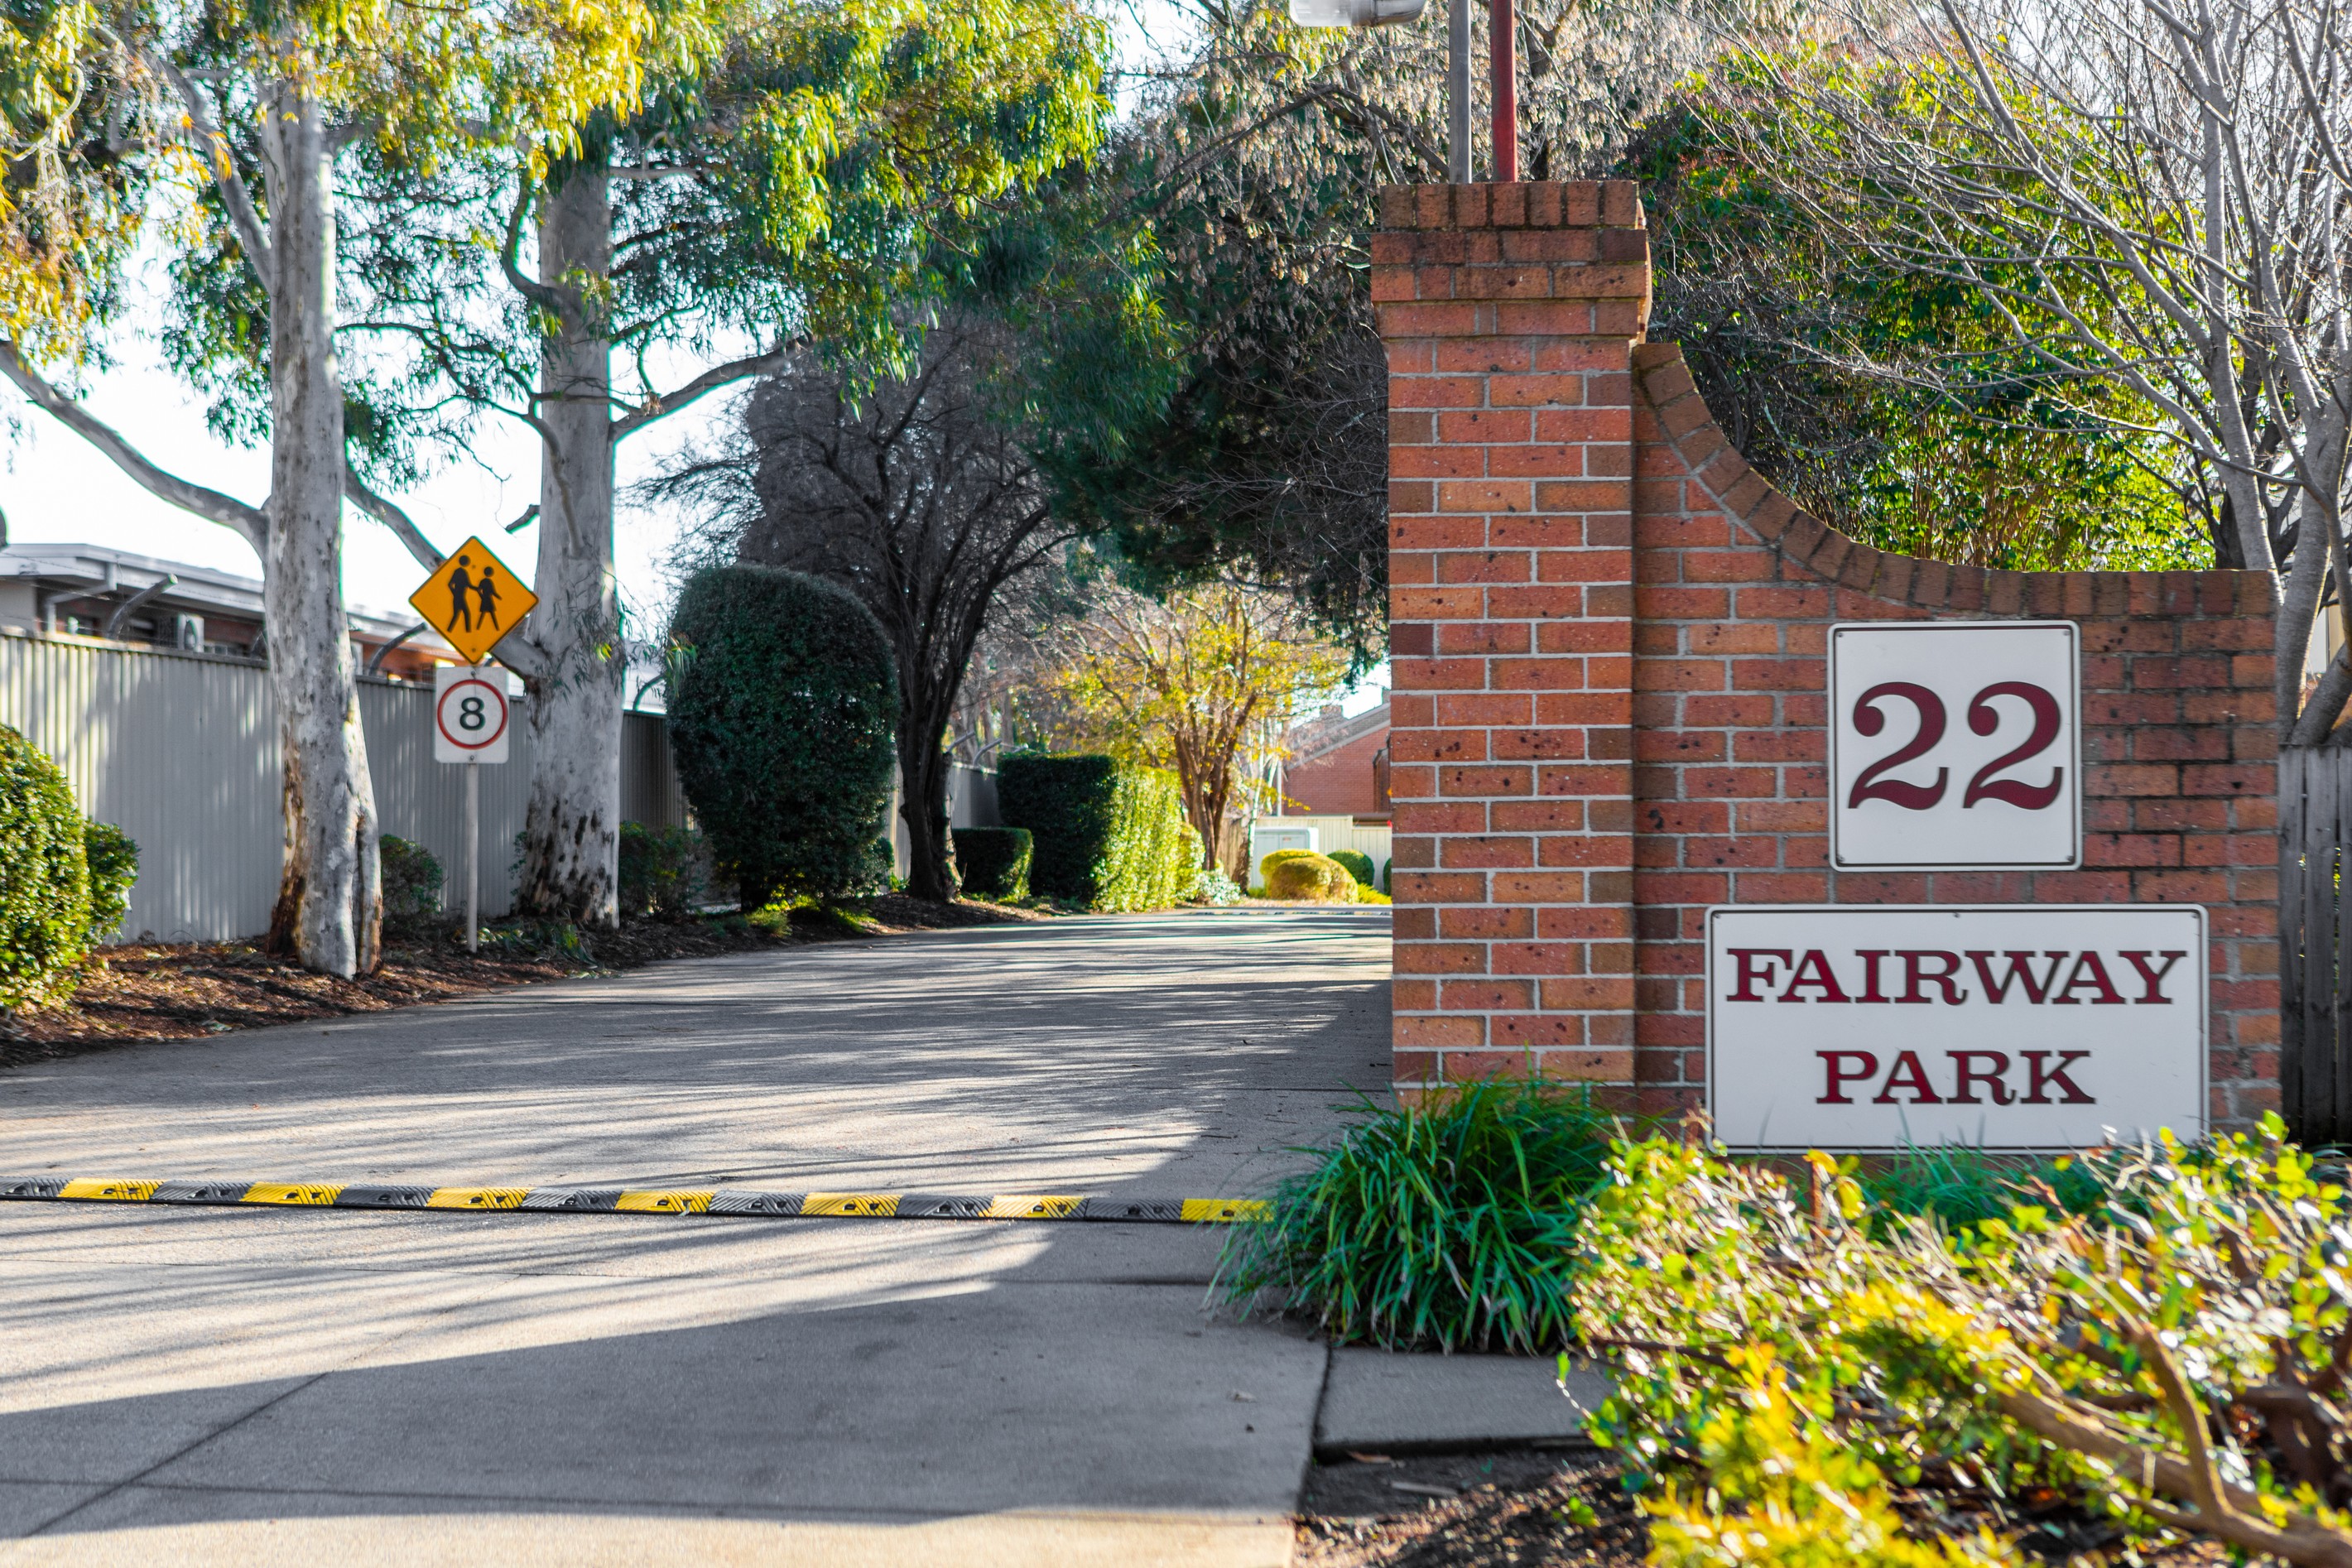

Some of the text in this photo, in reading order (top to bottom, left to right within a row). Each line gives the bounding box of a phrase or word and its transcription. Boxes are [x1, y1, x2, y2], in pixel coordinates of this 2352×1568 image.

[459, 697, 485, 730] 8
[1848, 681, 2064, 810] 22
[1726, 948, 2187, 1006] FAIRWAY
[1816, 1050, 2097, 1106] PARK
